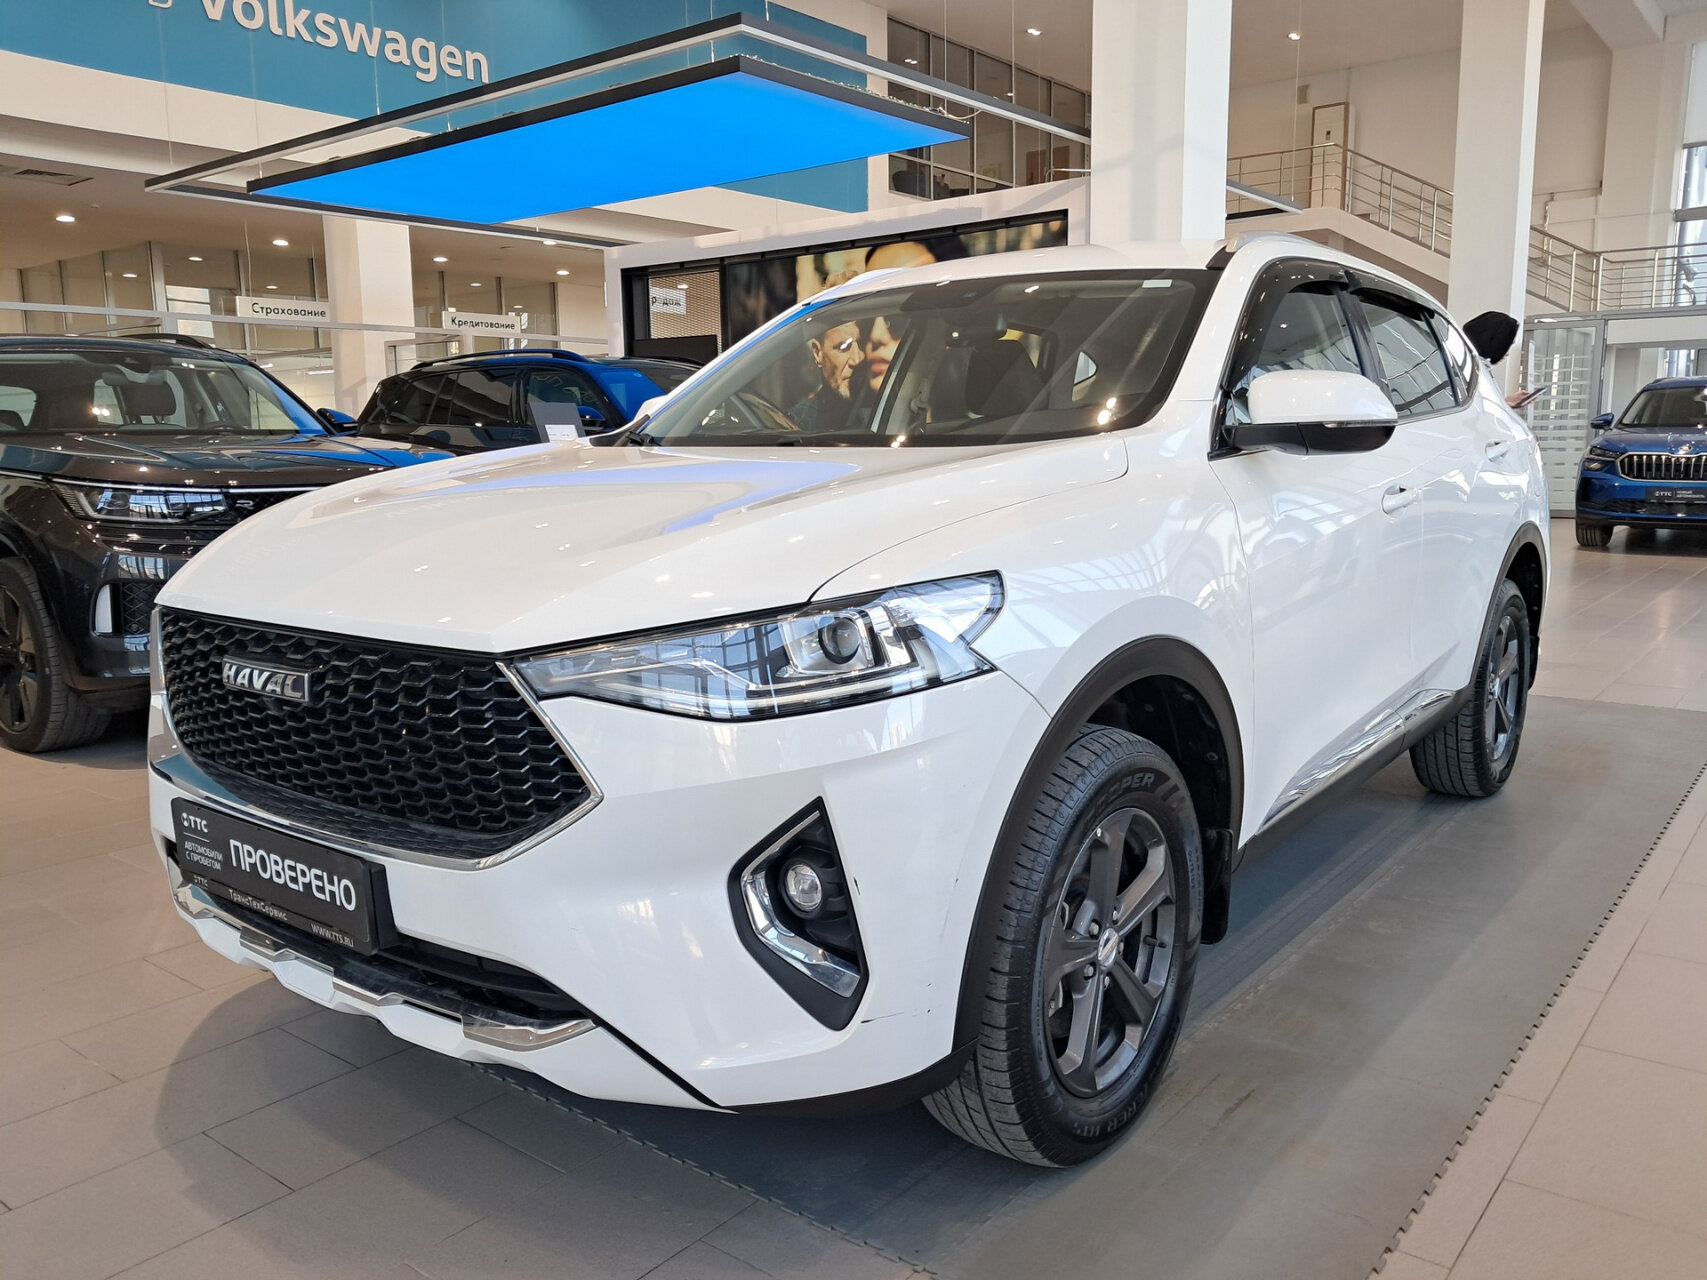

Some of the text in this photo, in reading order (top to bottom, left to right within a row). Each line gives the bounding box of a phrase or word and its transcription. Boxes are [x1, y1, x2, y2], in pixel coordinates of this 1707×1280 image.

[251, 302, 327, 317] Страхование
[450, 316, 516, 330] Кредитование
[222, 662, 303, 699] HAVAL
[188, 814, 209, 833] ТТС
[184, 840, 224, 862] АВТОМОБИЛИ
[185, 851, 222, 871] С ПРОБЕГОМ
[229, 838, 356, 912] ПРОВЕРЕНО
[228, 888, 288, 921] ТрансТехСервис
